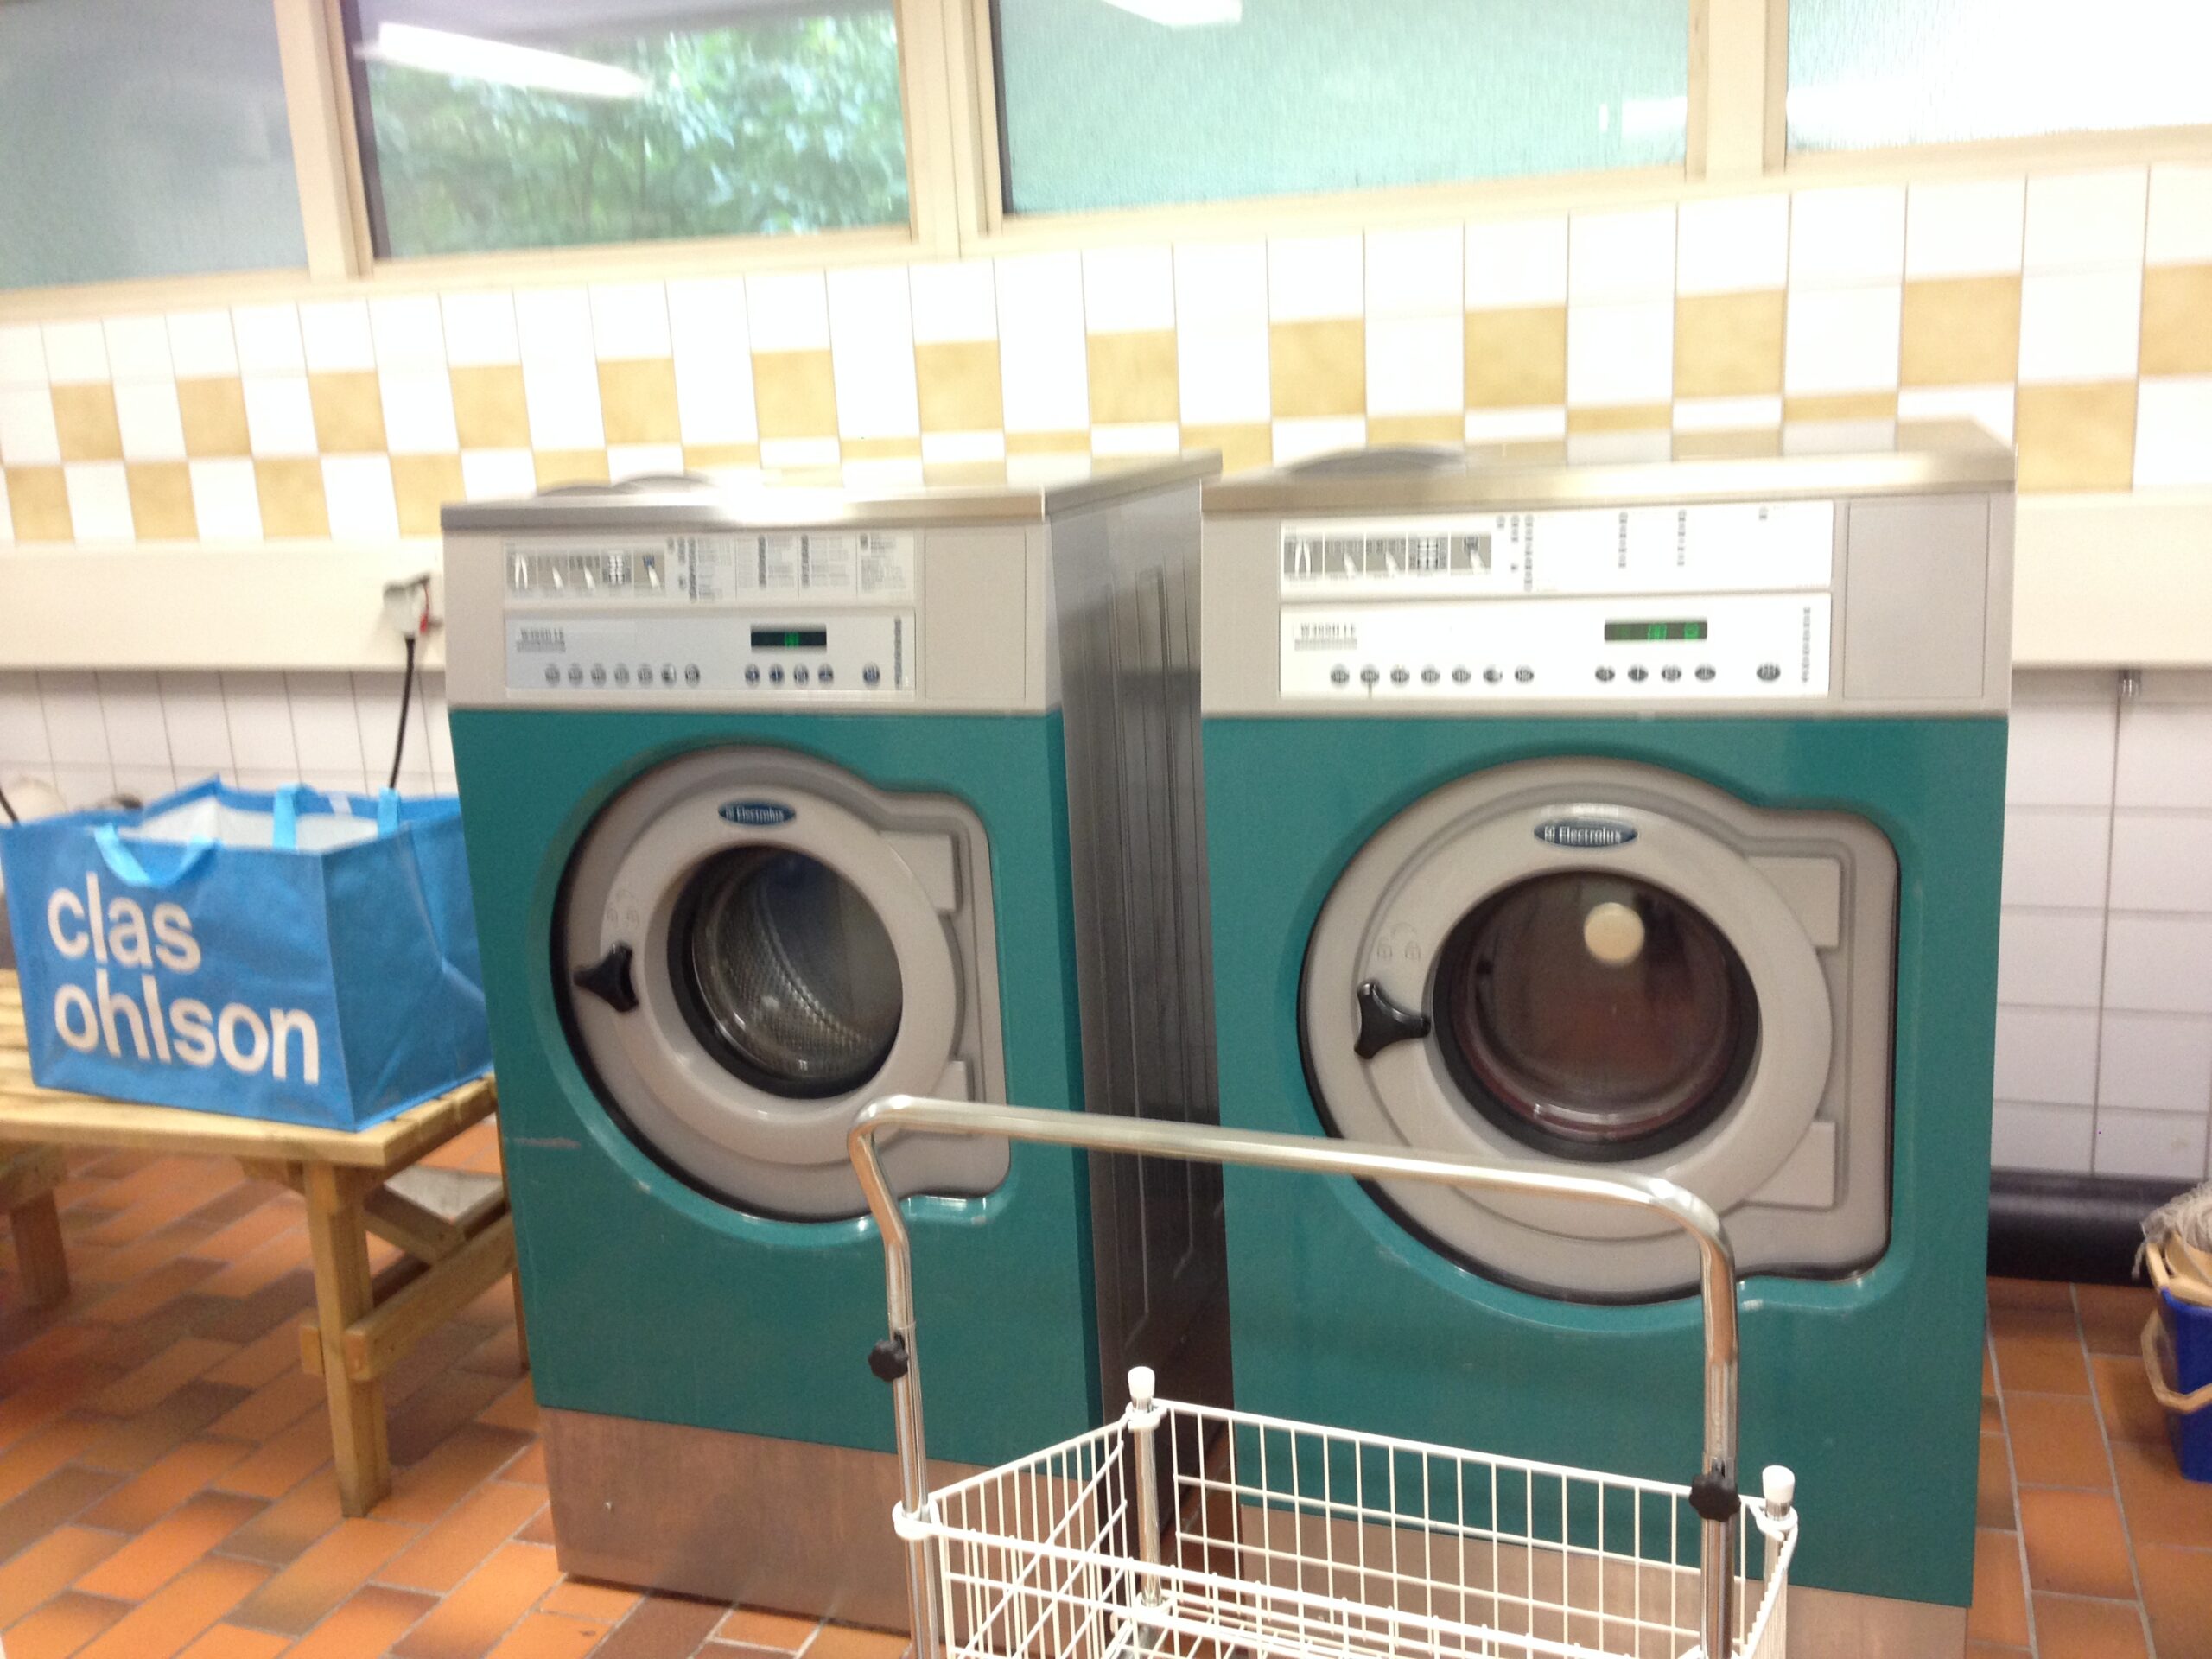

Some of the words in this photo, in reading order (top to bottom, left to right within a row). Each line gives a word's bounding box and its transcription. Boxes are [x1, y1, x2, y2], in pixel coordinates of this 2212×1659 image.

[1559, 825, 1621, 845] Electrolux
[47, 871, 202, 974] clas
[54, 968, 319, 1086] ohlson
